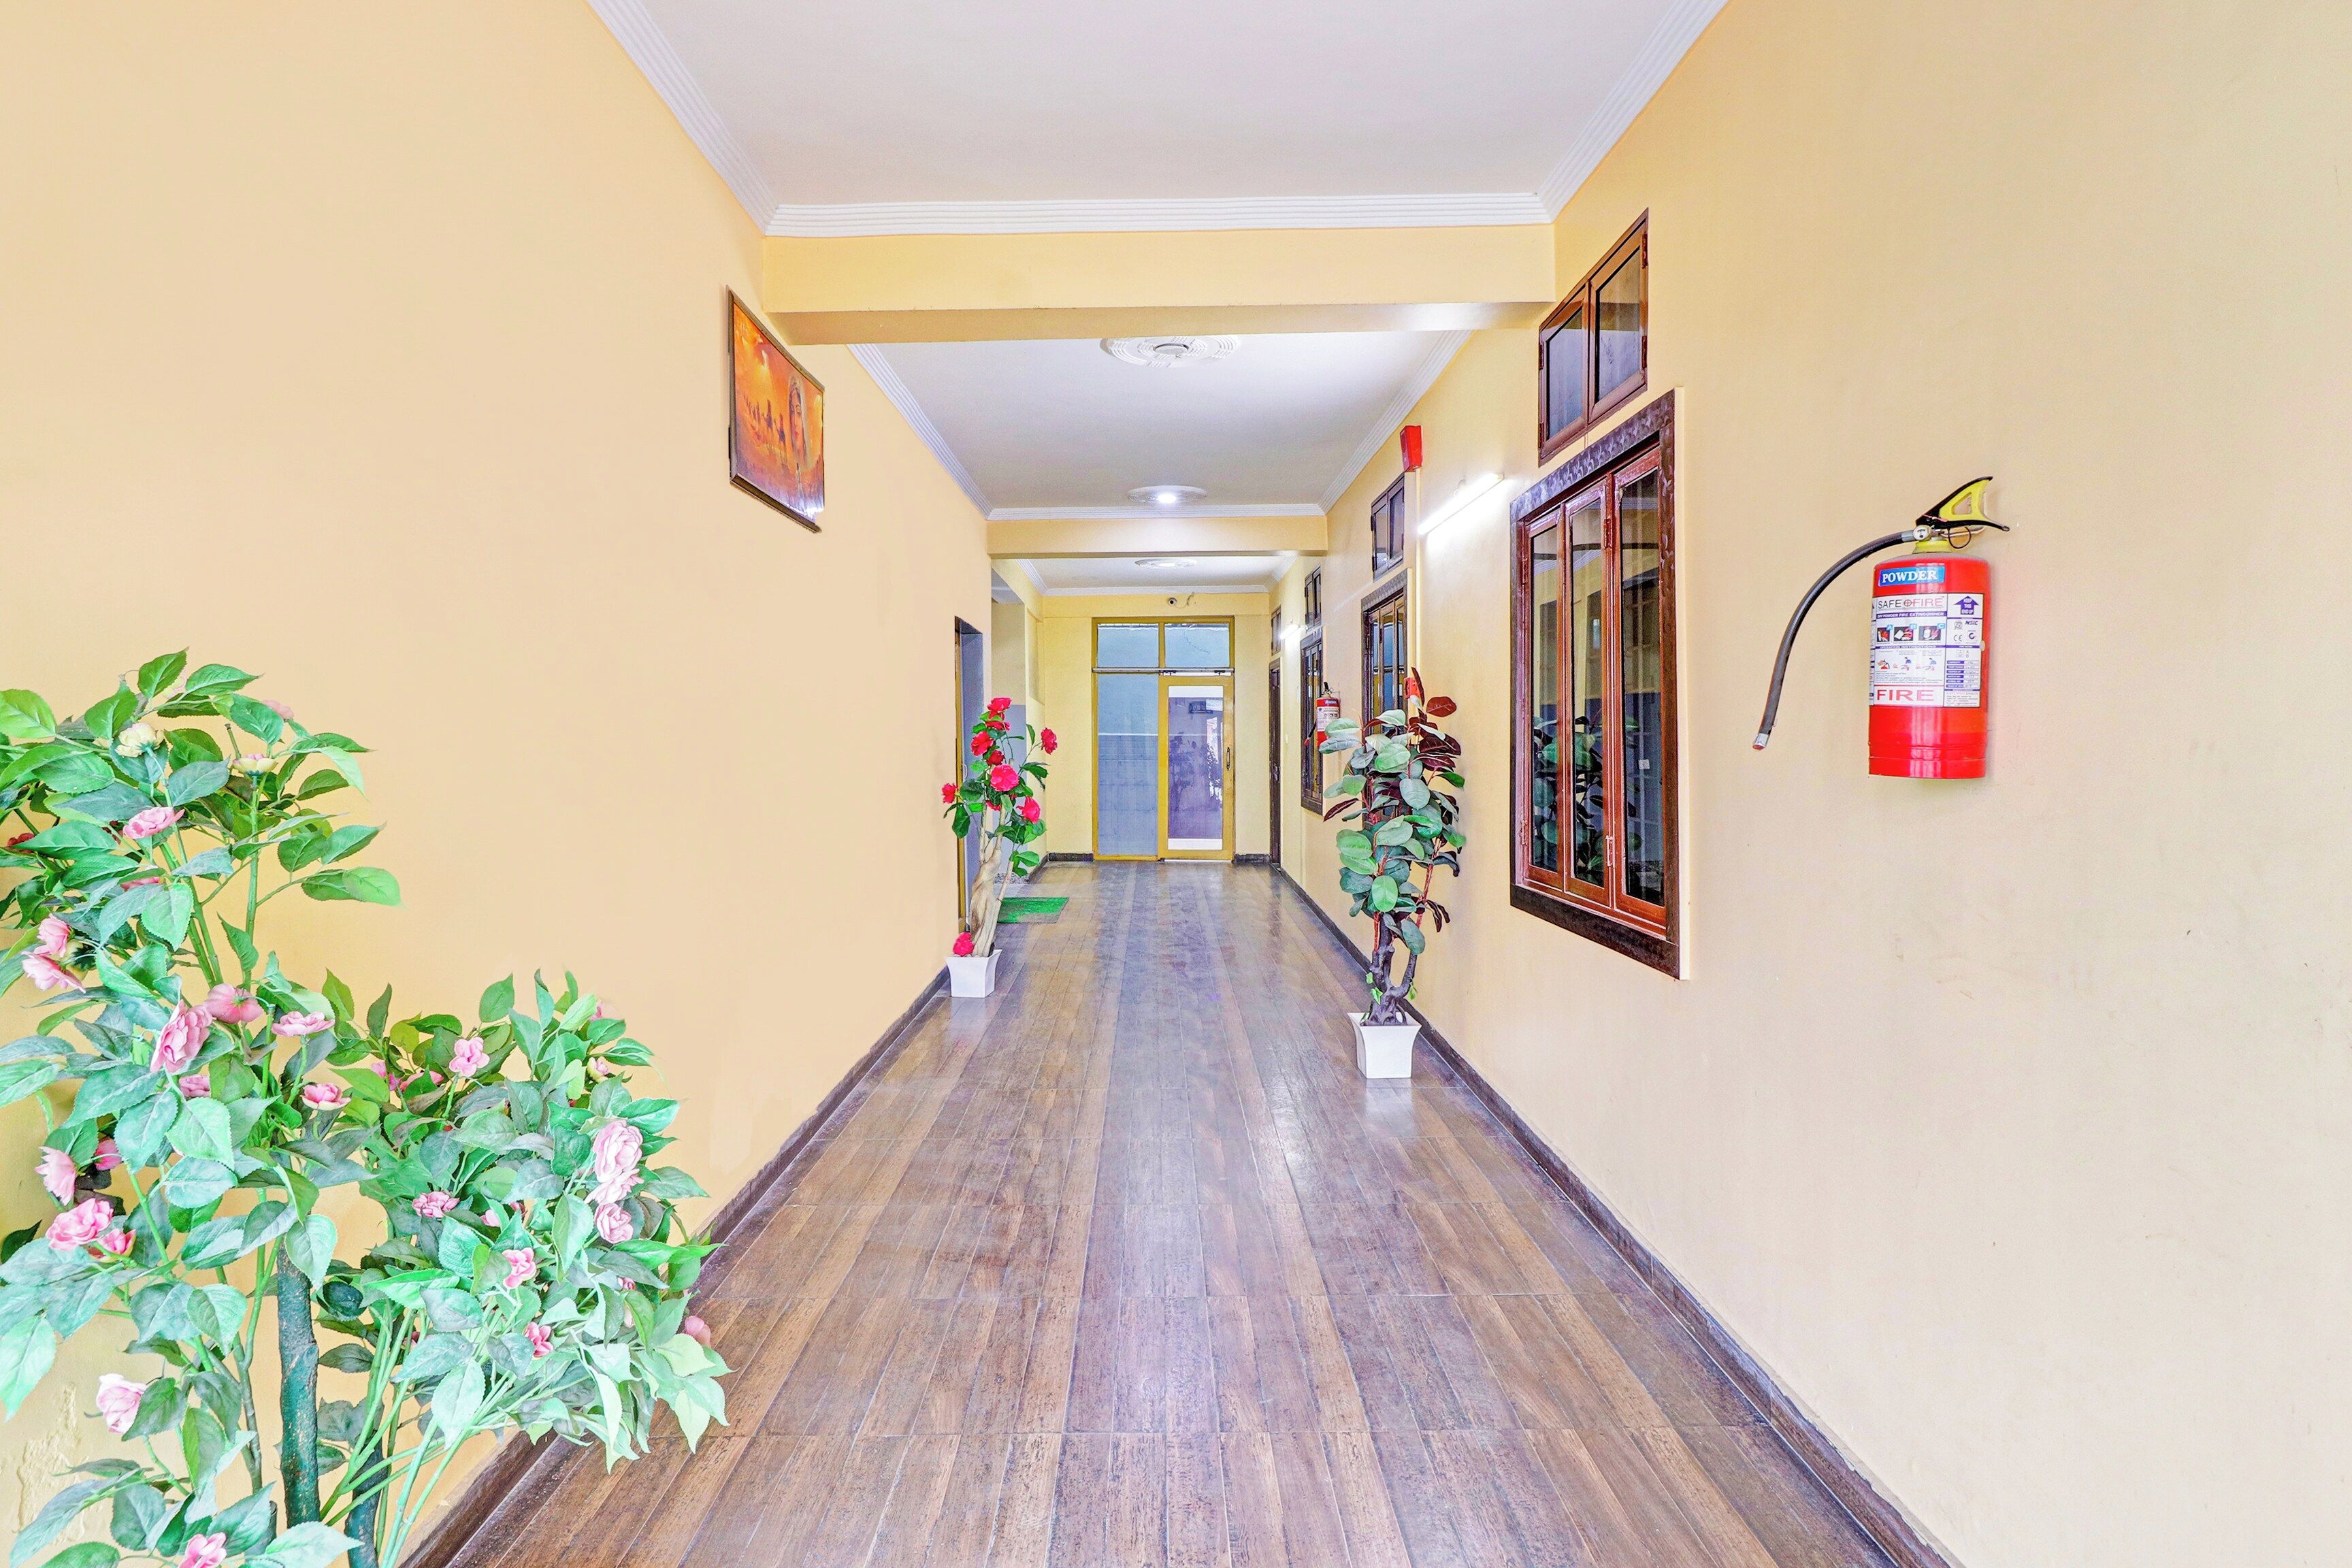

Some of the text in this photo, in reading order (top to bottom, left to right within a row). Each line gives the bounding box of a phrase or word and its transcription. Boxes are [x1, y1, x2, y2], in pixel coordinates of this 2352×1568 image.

[1882, 570, 1938, 583] POWDER
[1878, 598, 1943, 609] SAFE FIRE
[1877, 689, 1934, 701] FIRE
